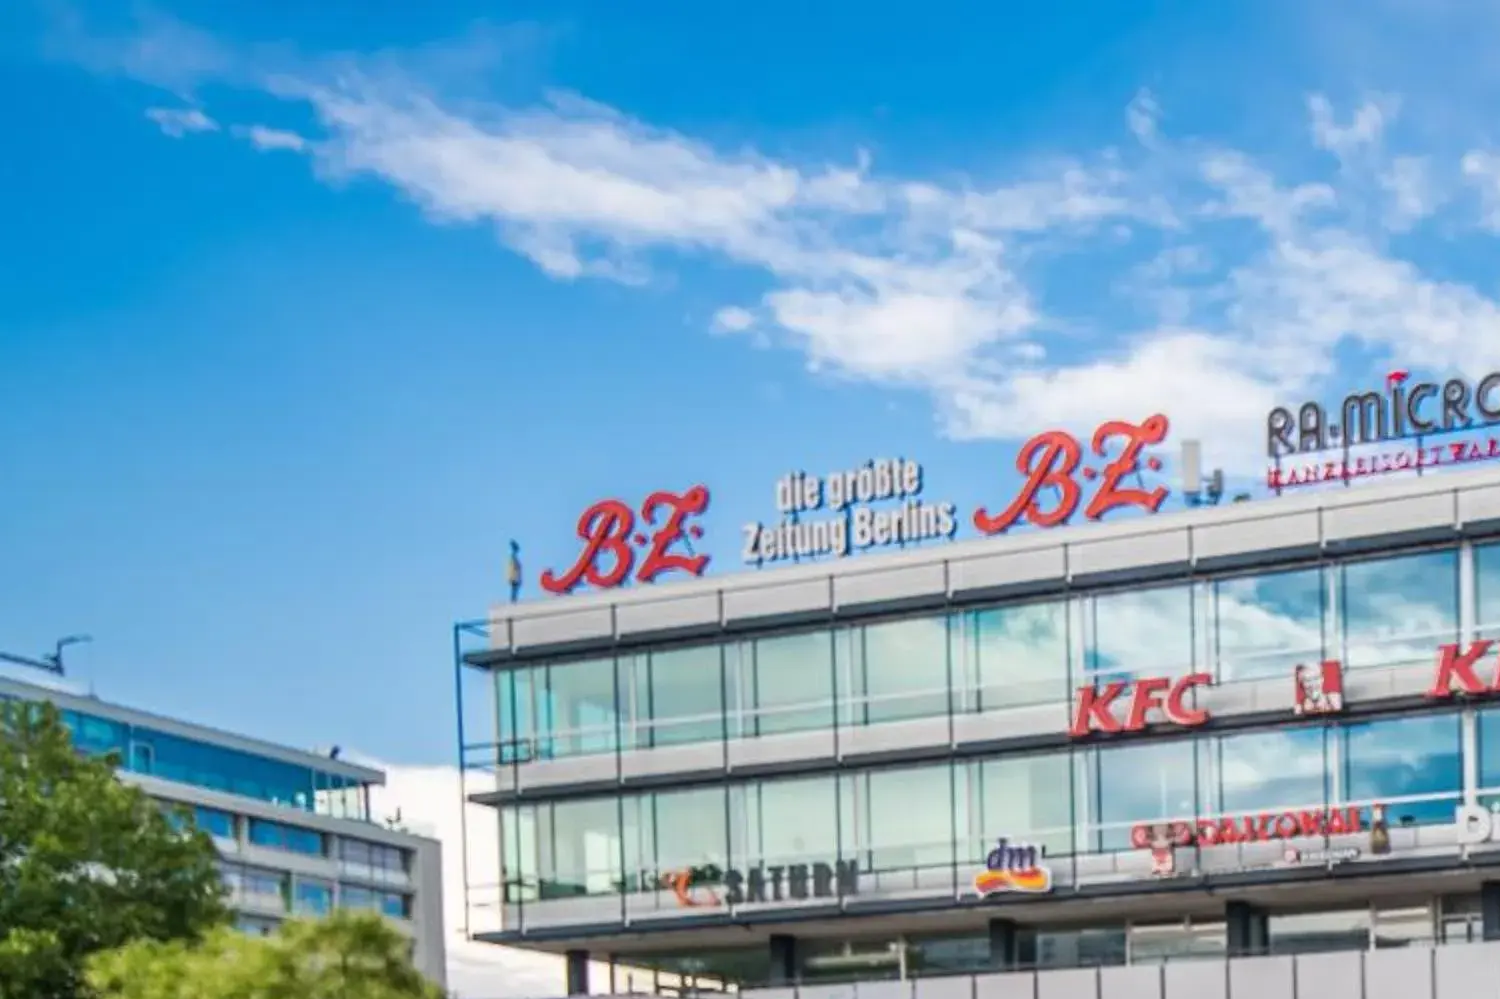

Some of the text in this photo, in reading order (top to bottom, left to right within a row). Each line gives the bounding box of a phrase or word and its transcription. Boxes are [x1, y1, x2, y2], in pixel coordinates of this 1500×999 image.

[775, 456, 923, 512] die größte
[742, 498, 957, 563] Zeitung Berlins
[1068, 672, 1219, 738] KFC
[724, 858, 860, 906] SATURN
[985, 837, 1039, 872] dm
